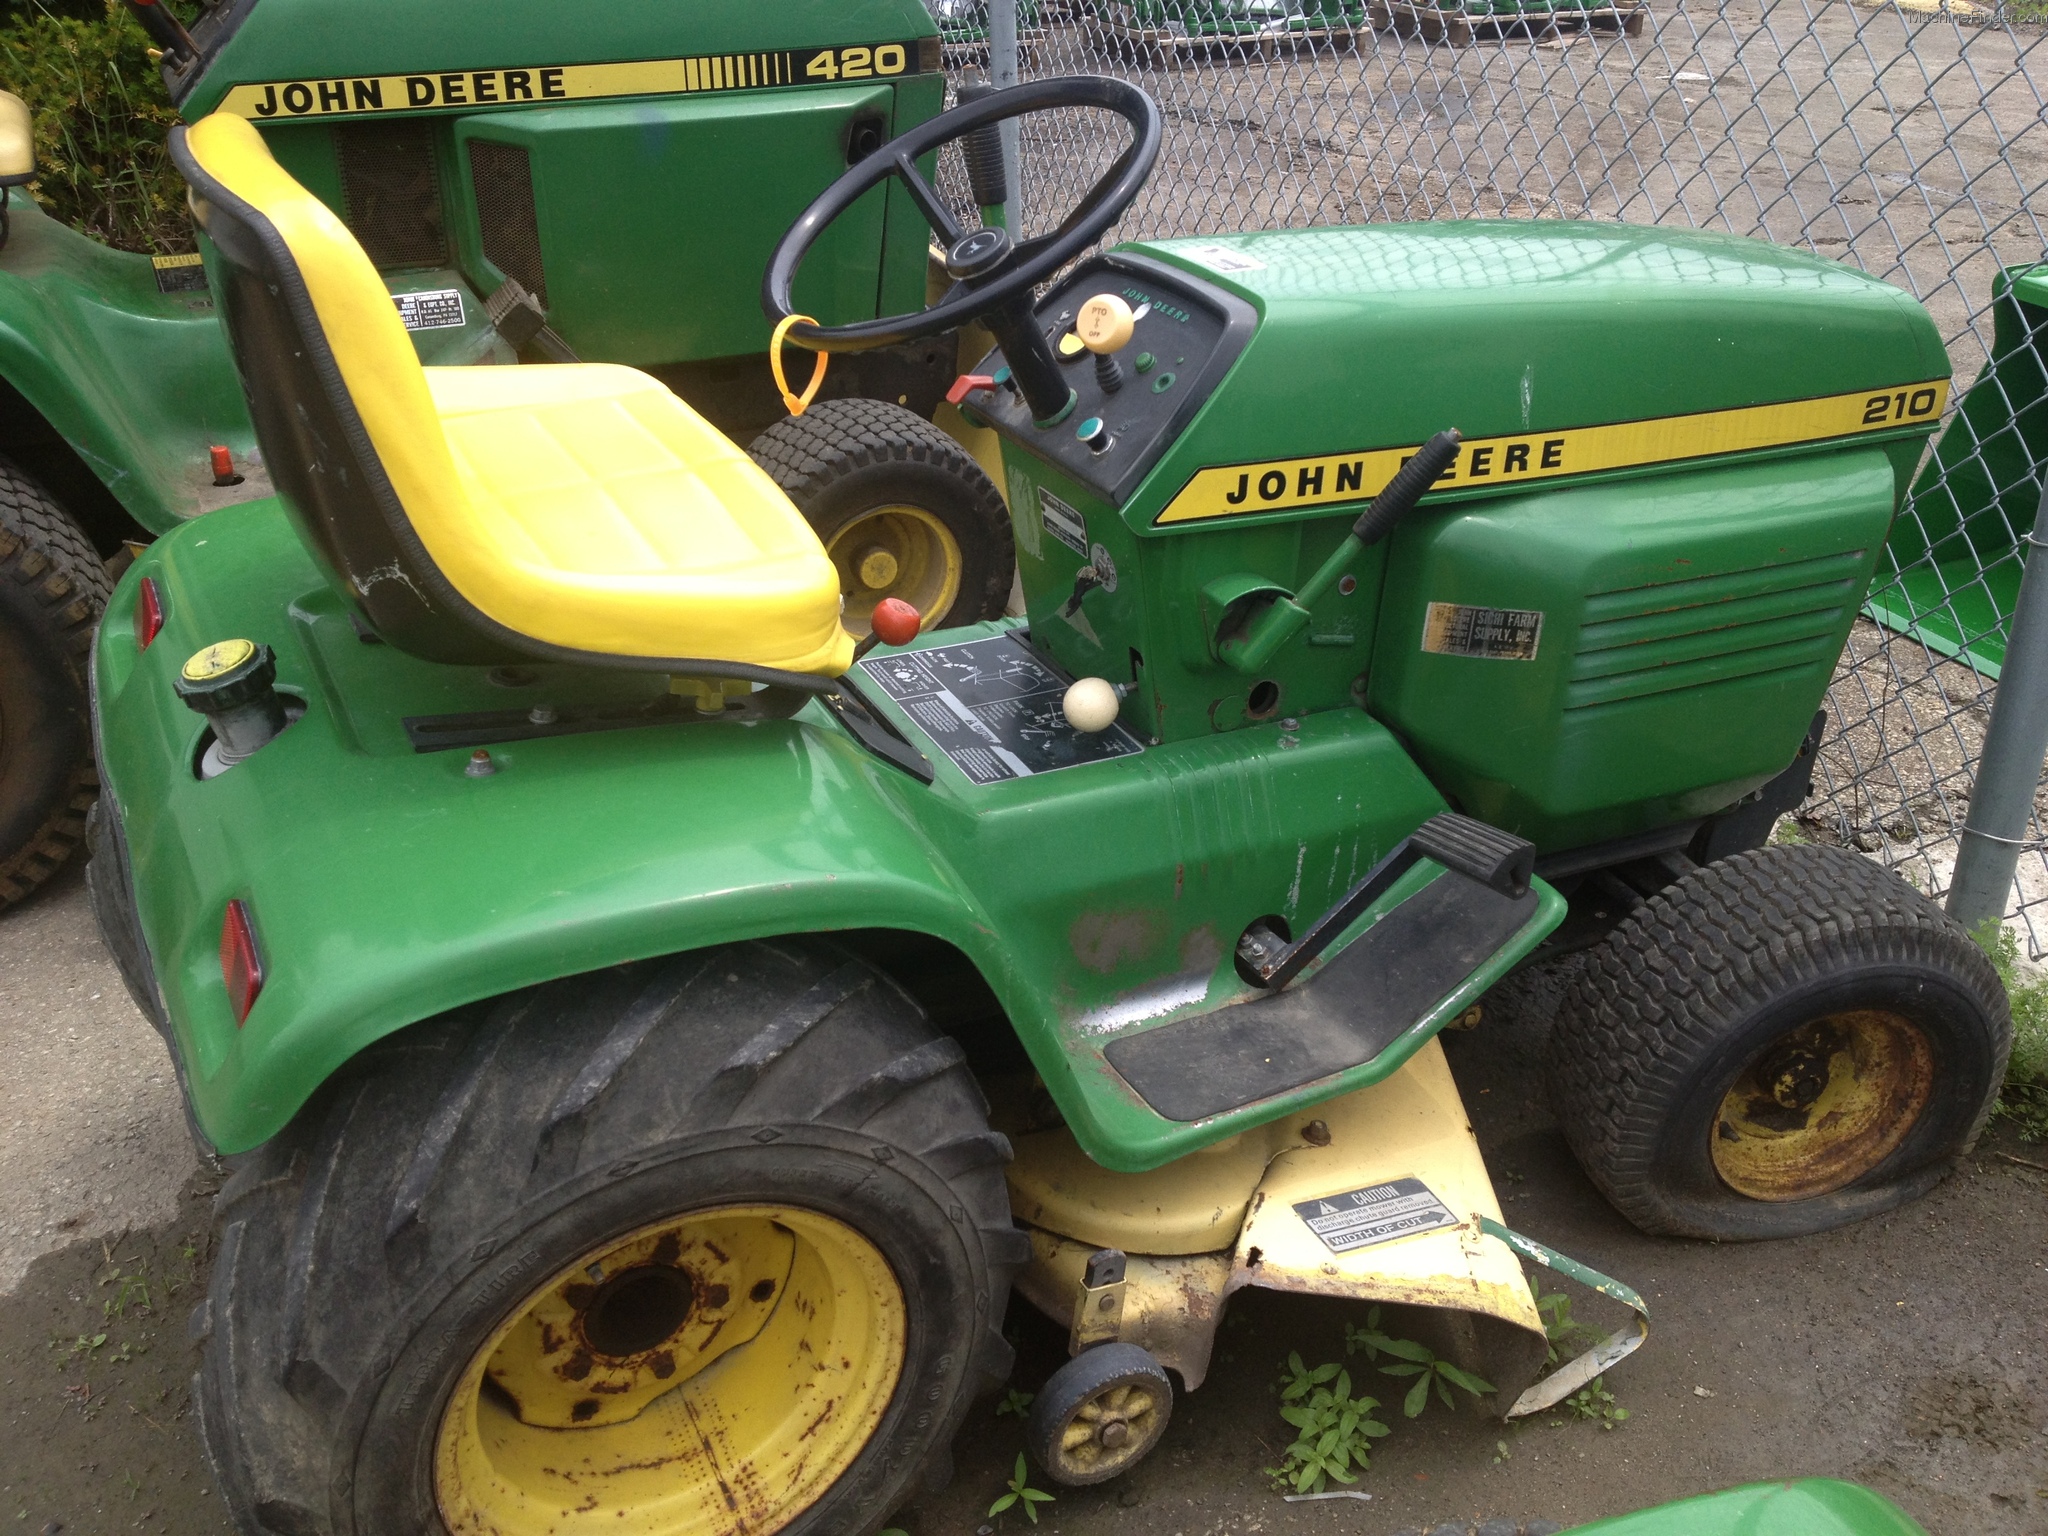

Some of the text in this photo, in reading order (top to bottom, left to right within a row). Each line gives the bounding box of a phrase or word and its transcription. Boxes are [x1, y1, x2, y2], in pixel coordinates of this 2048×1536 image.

[806, 44, 906, 80] 420
[255, 68, 566, 116] JOHN DEERE
[1122, 287, 1151, 304] JOHN
[1092, 307, 1107, 316] PTO
[1862, 388, 1936, 424] 210
[1226, 461, 1364, 505] JOHN
[1508, 613, 1537, 628] FARM
[1474, 626, 1512, 643] SUPPLY,
[1351, 1185, 1400, 1206] CAUTION
[1311, 1196, 1414, 1226] Do not operate mower with
[1317, 1219, 1355, 1231] discharge
[1356, 1212, 1378, 1223] chute
[1379, 1206, 1400, 1218] guard
[1330, 1216, 1423, 1245] WIDTH OF CUT
